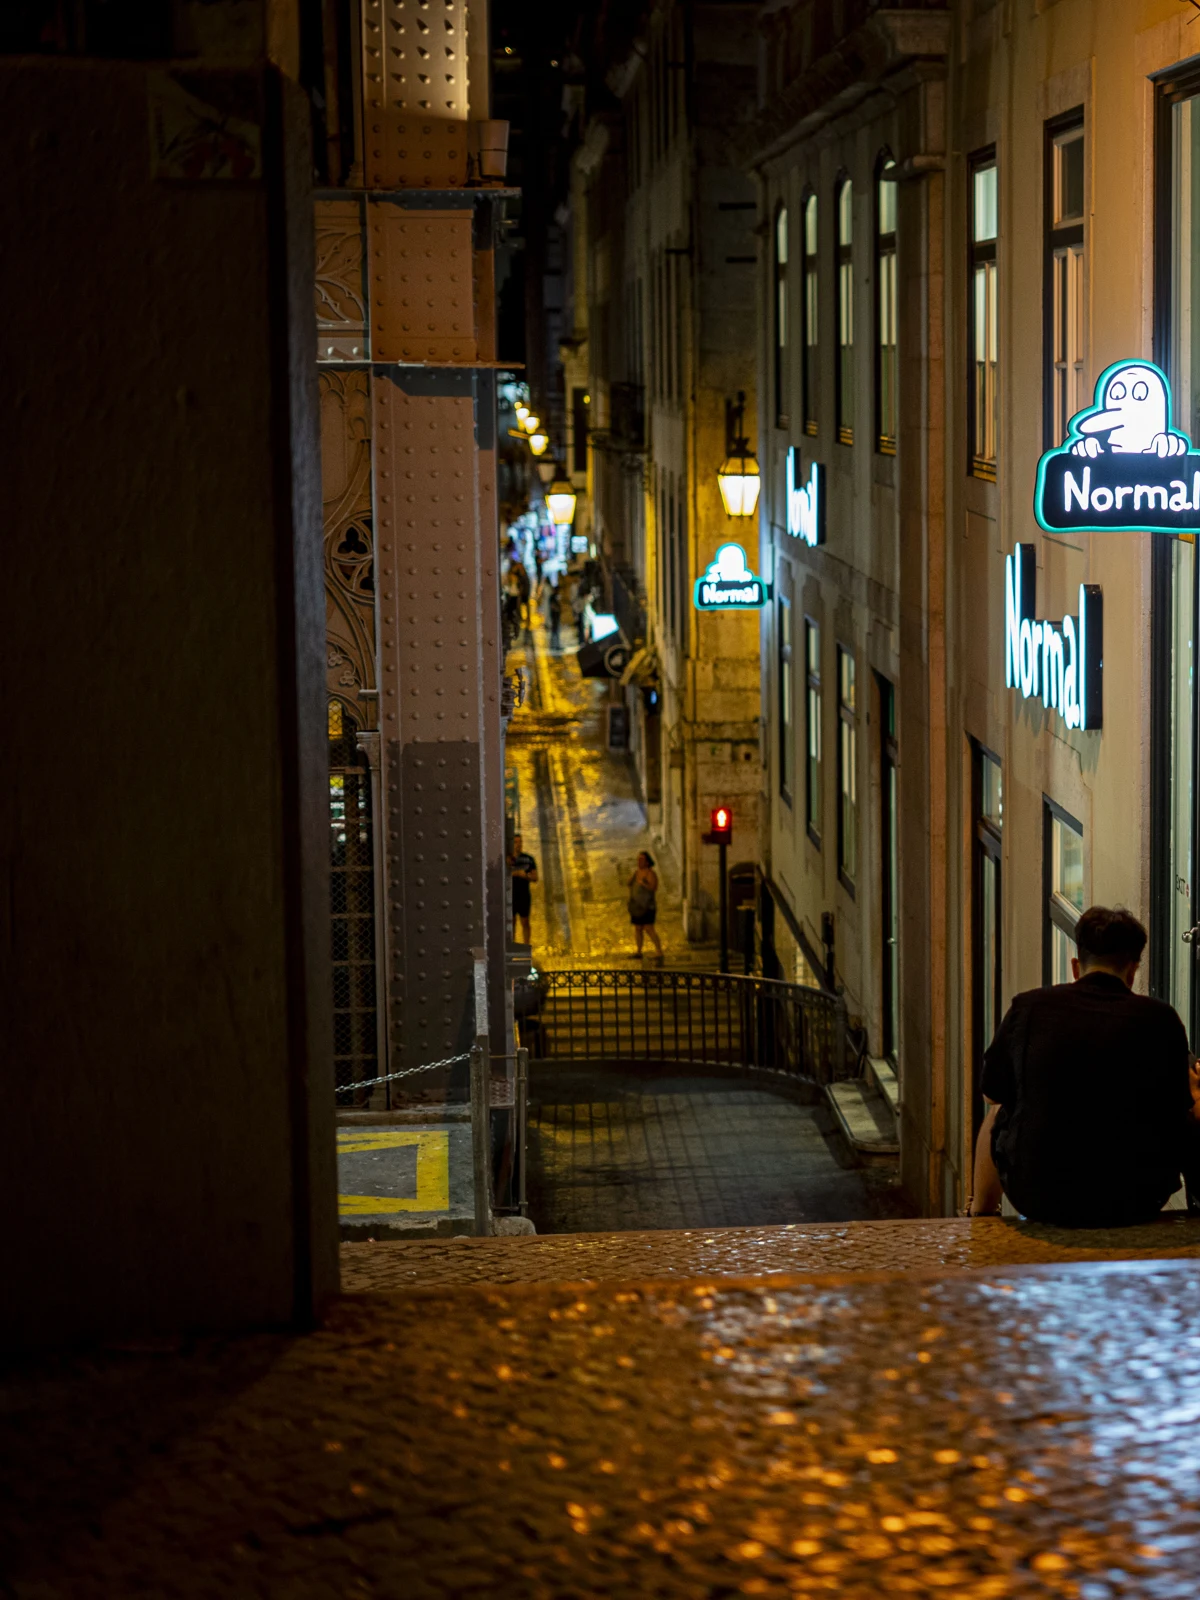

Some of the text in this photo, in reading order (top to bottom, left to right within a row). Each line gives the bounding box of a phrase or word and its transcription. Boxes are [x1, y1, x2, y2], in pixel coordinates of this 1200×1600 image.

[1063, 466, 1200, 512] Normal
[702, 583, 759, 604] Normal
[1005, 541, 1087, 731] Normal
